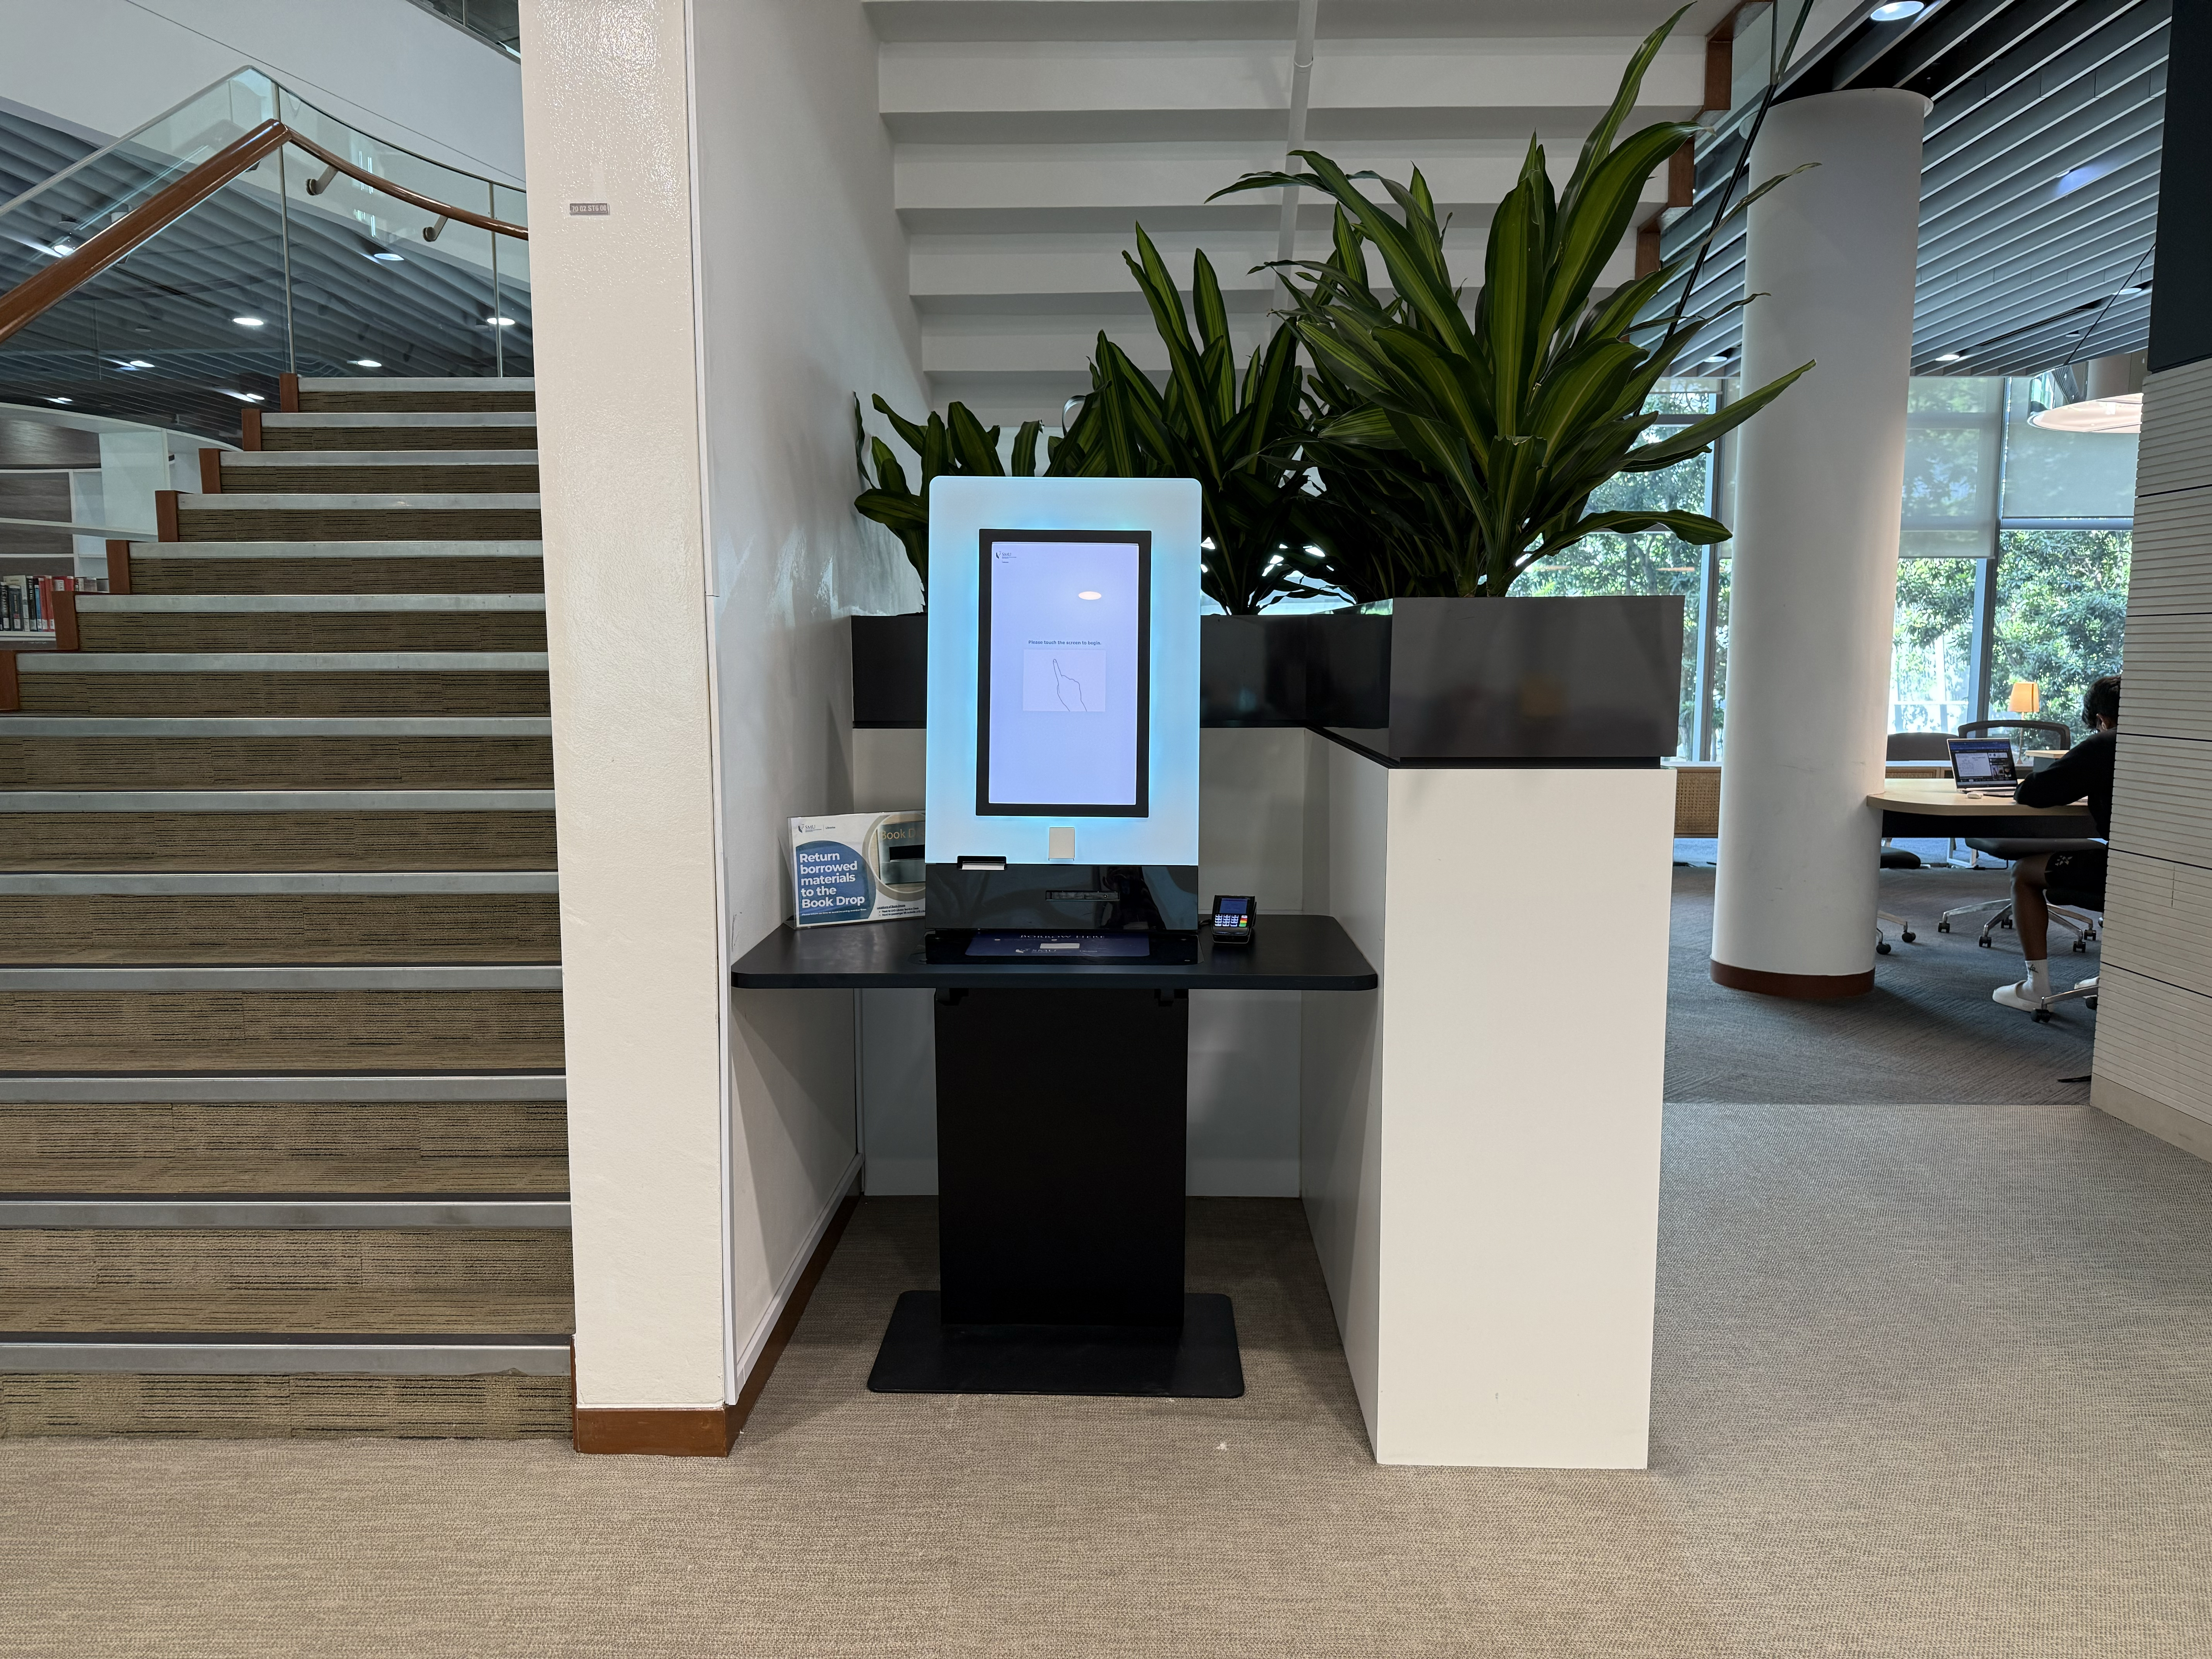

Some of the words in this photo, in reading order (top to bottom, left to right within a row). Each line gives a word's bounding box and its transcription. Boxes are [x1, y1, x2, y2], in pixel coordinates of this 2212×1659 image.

[881, 829, 906, 840] Book
[800, 853, 840, 863] Return
[800, 860, 858, 874] borrowed
[801, 872, 856, 886] materials
[801, 888, 814, 897] to
[816, 886, 837, 896] the
[802, 896, 834, 908] Book
[836, 896, 865, 906] Drop
